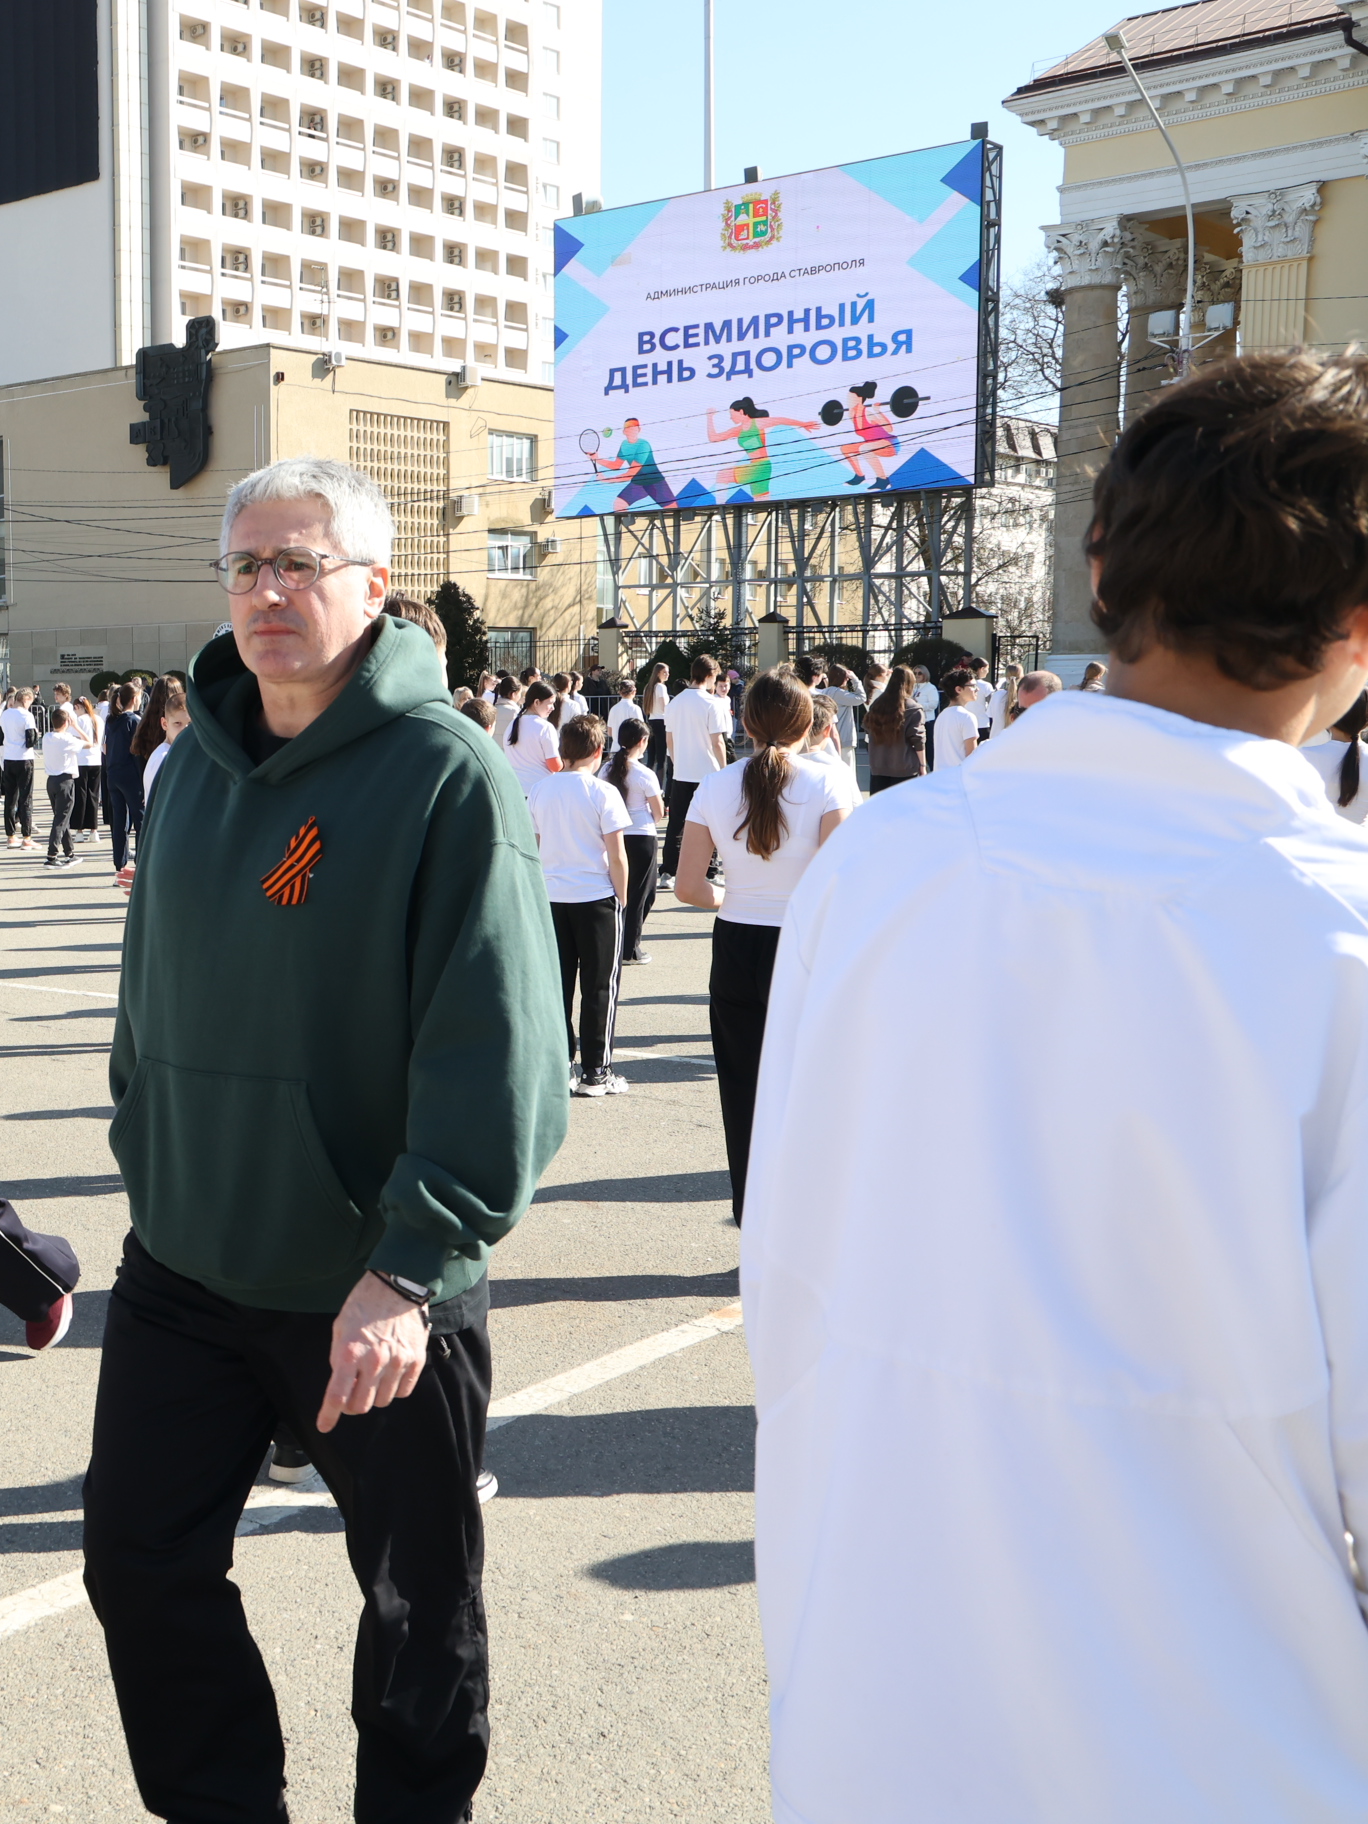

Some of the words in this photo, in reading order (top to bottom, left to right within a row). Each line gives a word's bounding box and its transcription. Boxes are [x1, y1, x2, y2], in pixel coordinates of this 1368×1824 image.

[645, 278, 741, 301] АДМИНИСТРАЦИЯ
[743, 270, 787, 287] ГОРОДА
[788, 258, 866, 280] СТАВРОПОЛЯ
[637, 291, 876, 356] ВСЕМИРНЫЙ
[603, 358, 696, 396] ДЕНЬ
[705, 328, 914, 382] ЗДОРОВЬЯ
